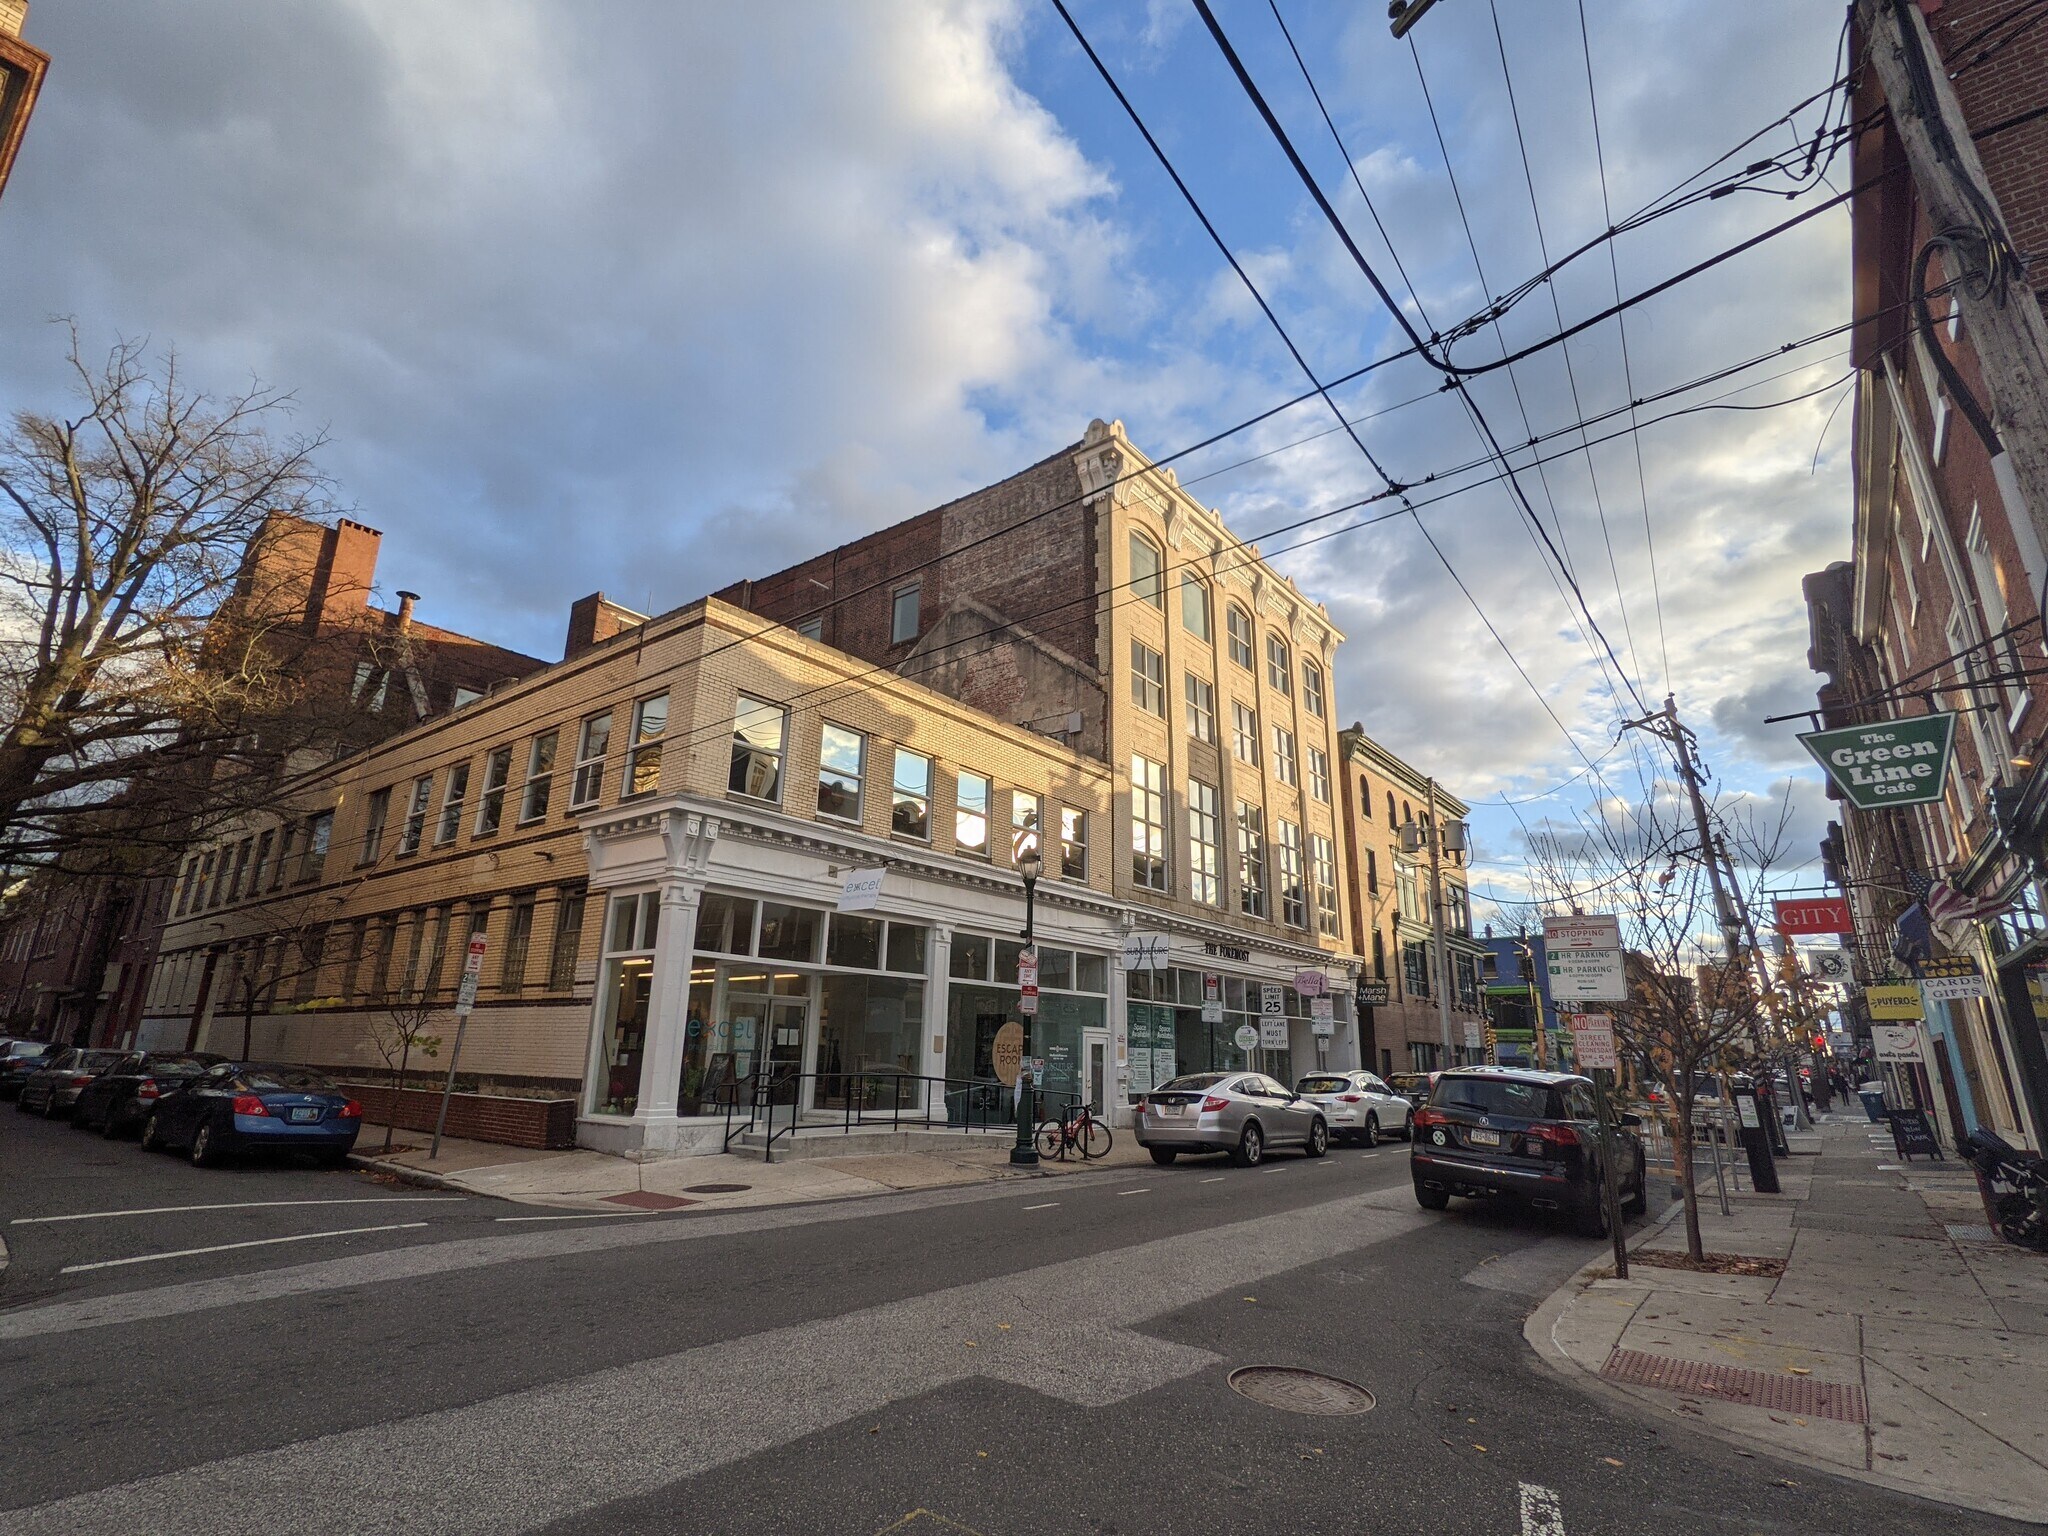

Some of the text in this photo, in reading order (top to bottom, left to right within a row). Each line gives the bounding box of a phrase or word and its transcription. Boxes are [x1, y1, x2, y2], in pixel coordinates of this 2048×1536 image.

[1860, 733, 1896, 745] The
[1831, 740, 1938, 766] Green
[1849, 762, 1932, 786] Line
[1874, 782, 1916, 795] Cafe
[846, 878, 880, 892] excel
[1561, 930, 1604, 938] STOPPING
[1205, 942, 1250, 962] THE FOREMOST
[1297, 976, 1318, 985] Bella
[1925, 977, 1981, 988] CARDS
[1932, 988, 1981, 998] GIFTS
[1265, 1002, 1281, 1012] 25
[1876, 997, 1910, 1006] PUYERO
[687, 1020, 752, 1038] excel
[1574, 1016, 1587, 1030] NO
[997, 1044, 1023, 1053] ESCAP
